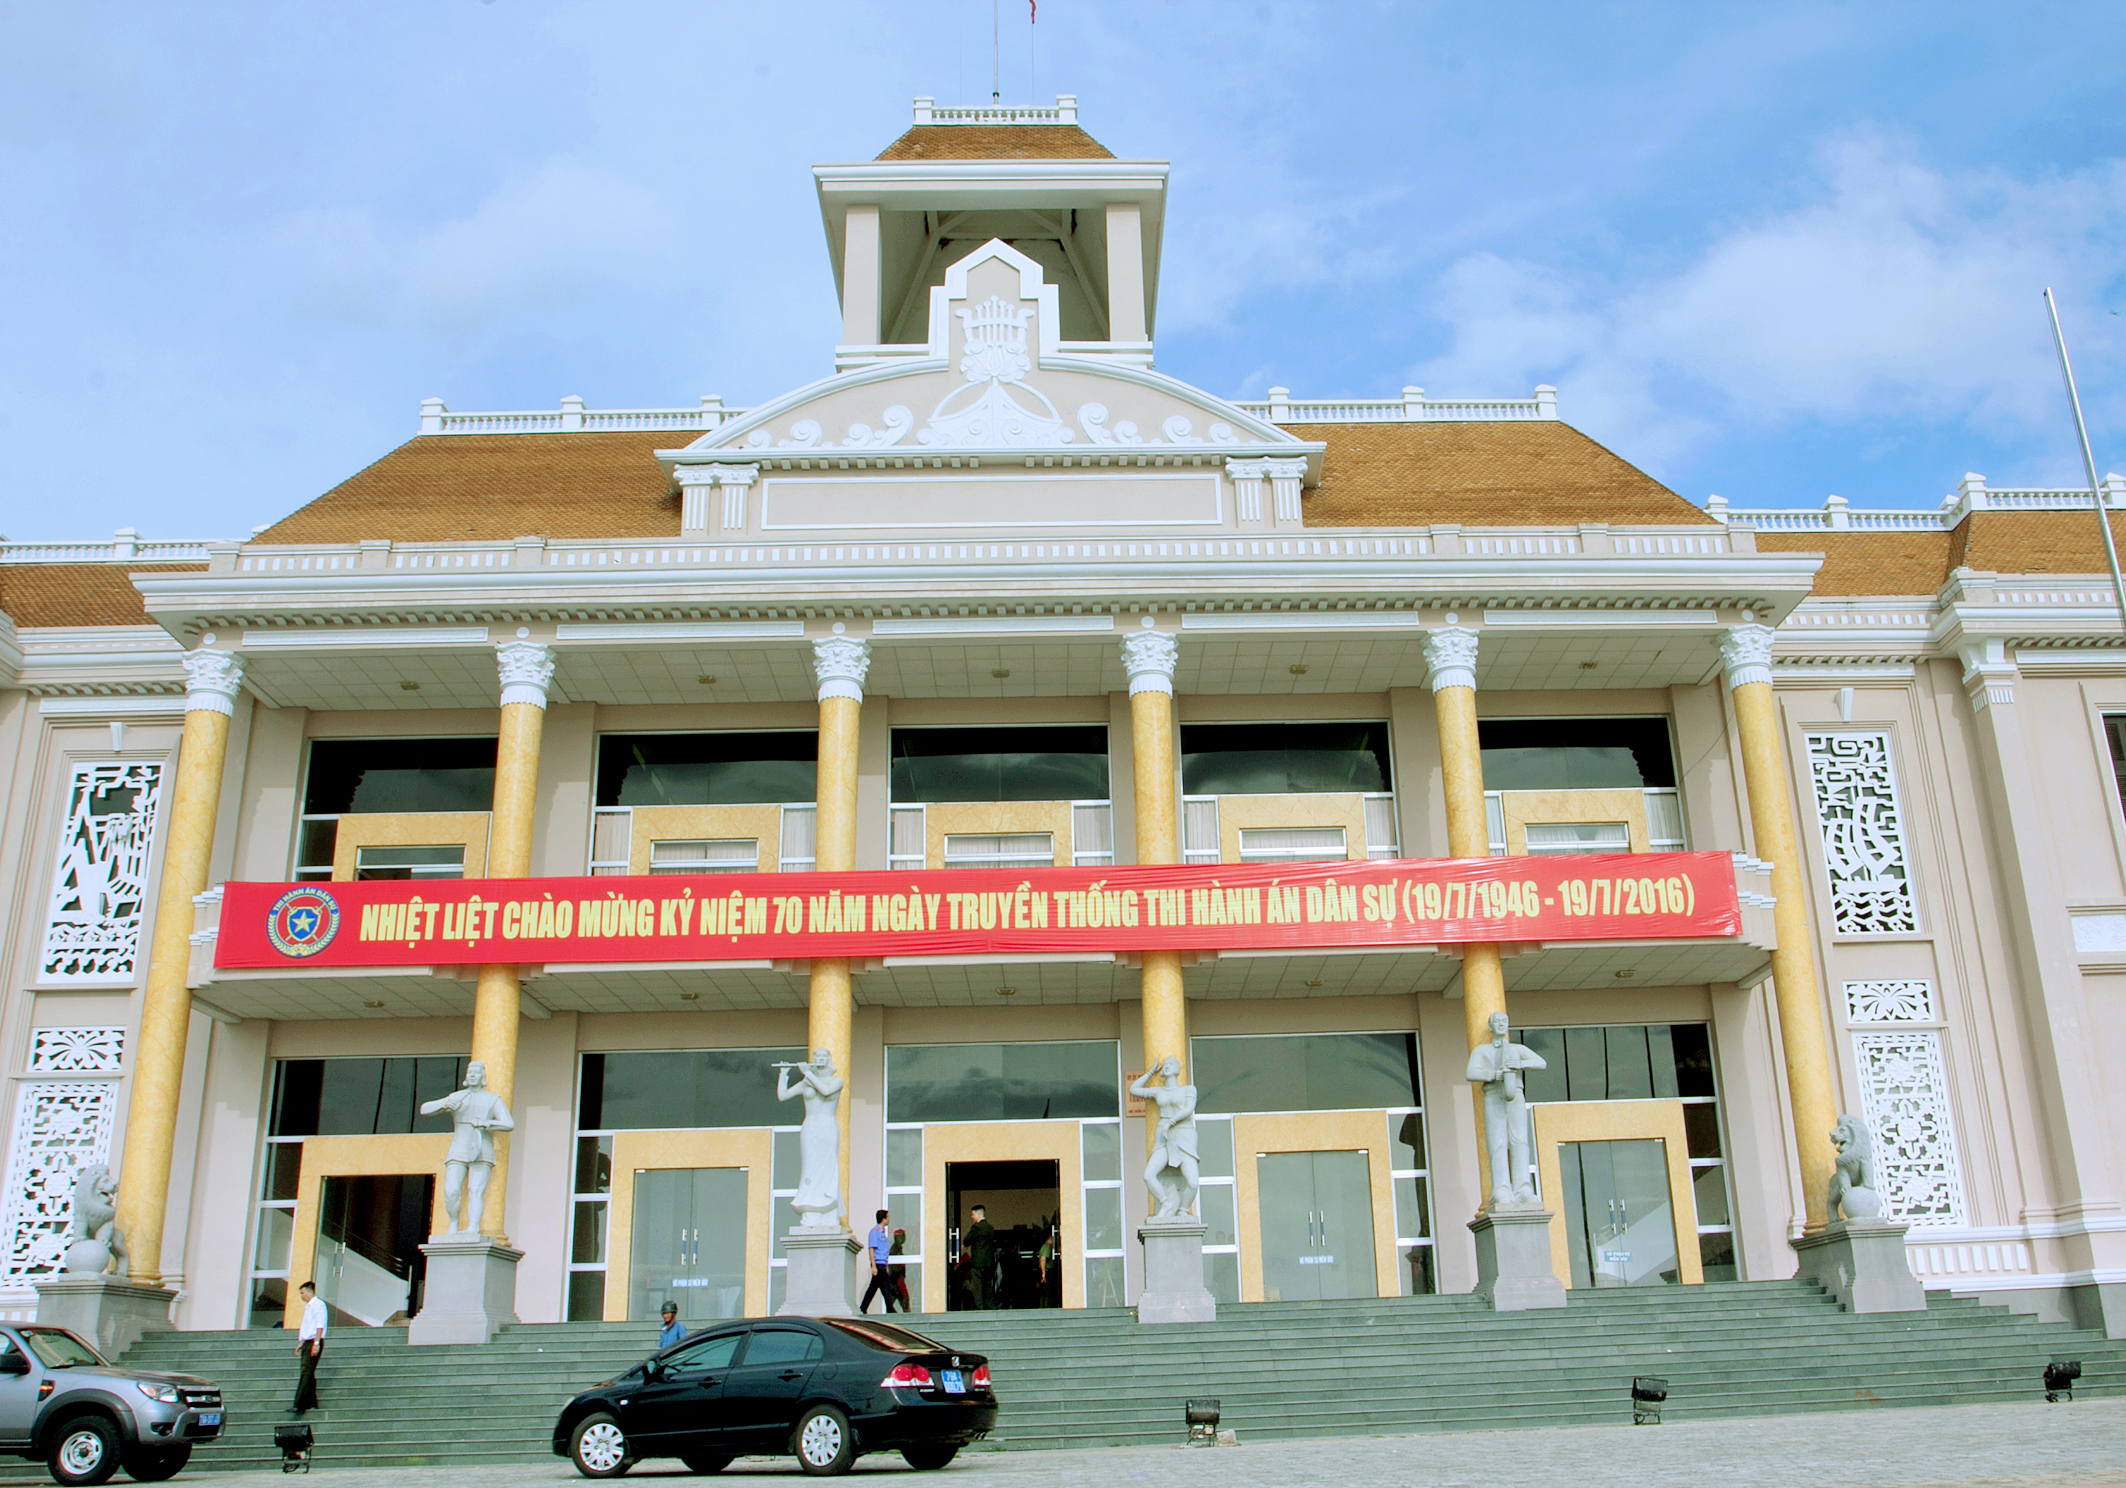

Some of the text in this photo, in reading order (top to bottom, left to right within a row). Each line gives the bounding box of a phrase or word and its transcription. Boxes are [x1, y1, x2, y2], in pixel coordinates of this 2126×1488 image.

[360, 872, 1696, 949] NHIỆT LIỆT CHÀO MỪNG KỶ NIỆM 70 NĂM NGÀY TRUYỀN THỐNG THI HÀNH ÁN DÂN SỰ (19/7/1946 - 19/7/2016)
